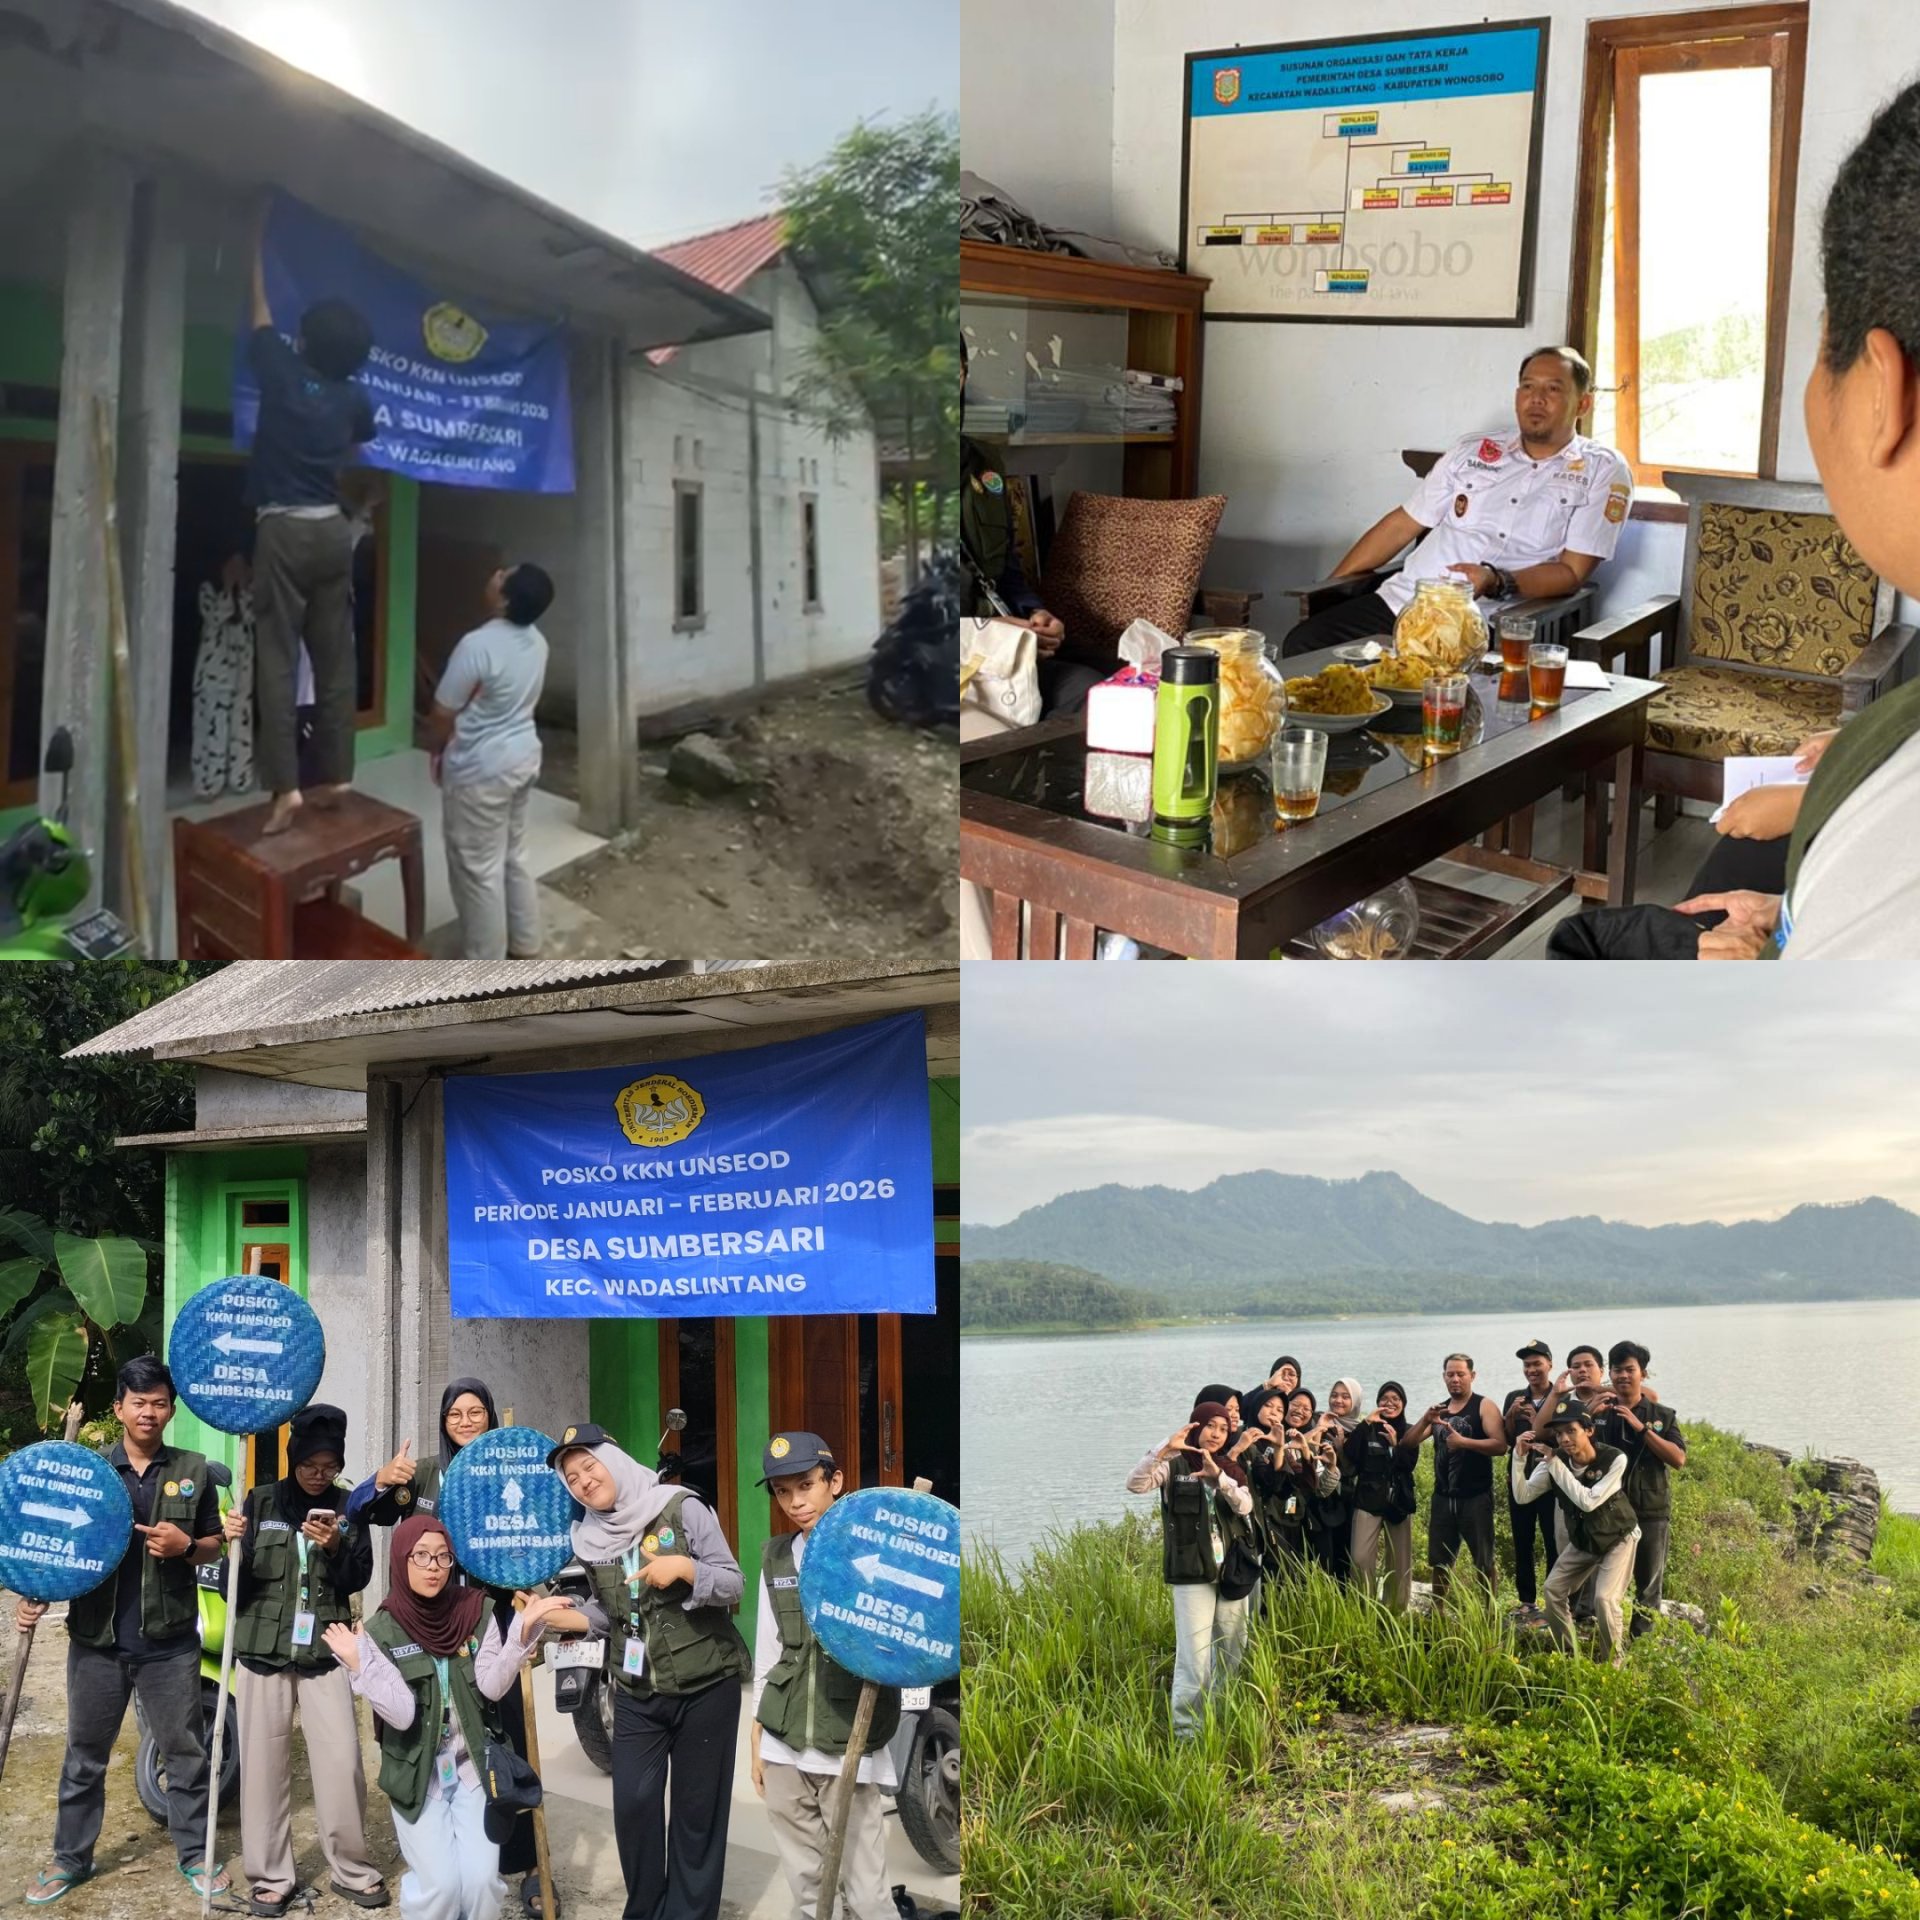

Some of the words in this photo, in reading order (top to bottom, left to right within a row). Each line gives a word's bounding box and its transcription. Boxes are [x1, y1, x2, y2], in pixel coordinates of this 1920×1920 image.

[1280, 62, 1324, 72] SUSUNAN
[1326, 54, 1384, 68] ORGANISASI
[1386, 52, 1406, 63] DAN
[1408, 49, 1433, 60] TATA
[1435, 47, 1468, 57] KERJA
[1247, 89, 1301, 101] KECAMATAN
[1303, 83, 1376, 97] WADASLINTANG
[1383, 79, 1441, 91] KABUPATEN
[1444, 72, 1505, 86] WONOSOBO
[1296, 70, 1356, 84] PEMERINTAH
[1357, 68, 1382, 79] DESA
[1385, 63, 1449, 77] SUMBERSARI
[1238, 229, 1474, 280] wonosobo
[400, 409, 523, 448] SUMBERSARI
[1552, 471, 1589, 487] KADES
[633, 1080, 677, 1092] JENDERAL
[622, 1089, 638, 1135] UNIVERSITAS
[676, 1086, 699, 1129] SOEDIRMAN
[648, 1135, 670, 1143] 1963
[541, 1164, 618, 1186] POSKO
[622, 1160, 675, 1181] KKN
[679, 1150, 791, 1177] UNSEOD
[474, 1203, 560, 1223] PERIODE
[562, 1197, 664, 1220] JANUARI
[689, 1185, 819, 1214] FEBRUARI
[824, 1177, 896, 1203] 2026
[528, 1238, 602, 1261] DESA
[606, 1226, 825, 1260] SUMBERSARI
[545, 1279, 598, 1297] KEC.
[603, 1273, 807, 1297] WADASLINTANG
[222, 1294, 279, 1310] POSKO
[205, 1311, 234, 1324] KKN
[235, 1313, 292, 1328] UNSOED
[213, 1364, 270, 1384] DESA
[189, 1383, 294, 1401] SUMBERSARI
[484, 1446, 539, 1460] POSKO
[36, 1458, 94, 1482] POSKO
[470, 1464, 497, 1476] KKN
[17, 1473, 45, 1488] KKN
[47, 1478, 104, 1500] UNSOED
[485, 1514, 540, 1531] DESA
[874, 1506, 949, 1542] POSKO
[20, 1530, 76, 1557] DESA
[468, 1534, 571, 1549] SUMBERSARI
[850, 1524, 886, 1547] KKN
[888, 1533, 960, 1569] UNSOED
[0, 1544, 104, 1572] SUMBERSARI
[855, 1591, 927, 1632] DESA
[819, 1602, 956, 1660] SUMBERSARI
